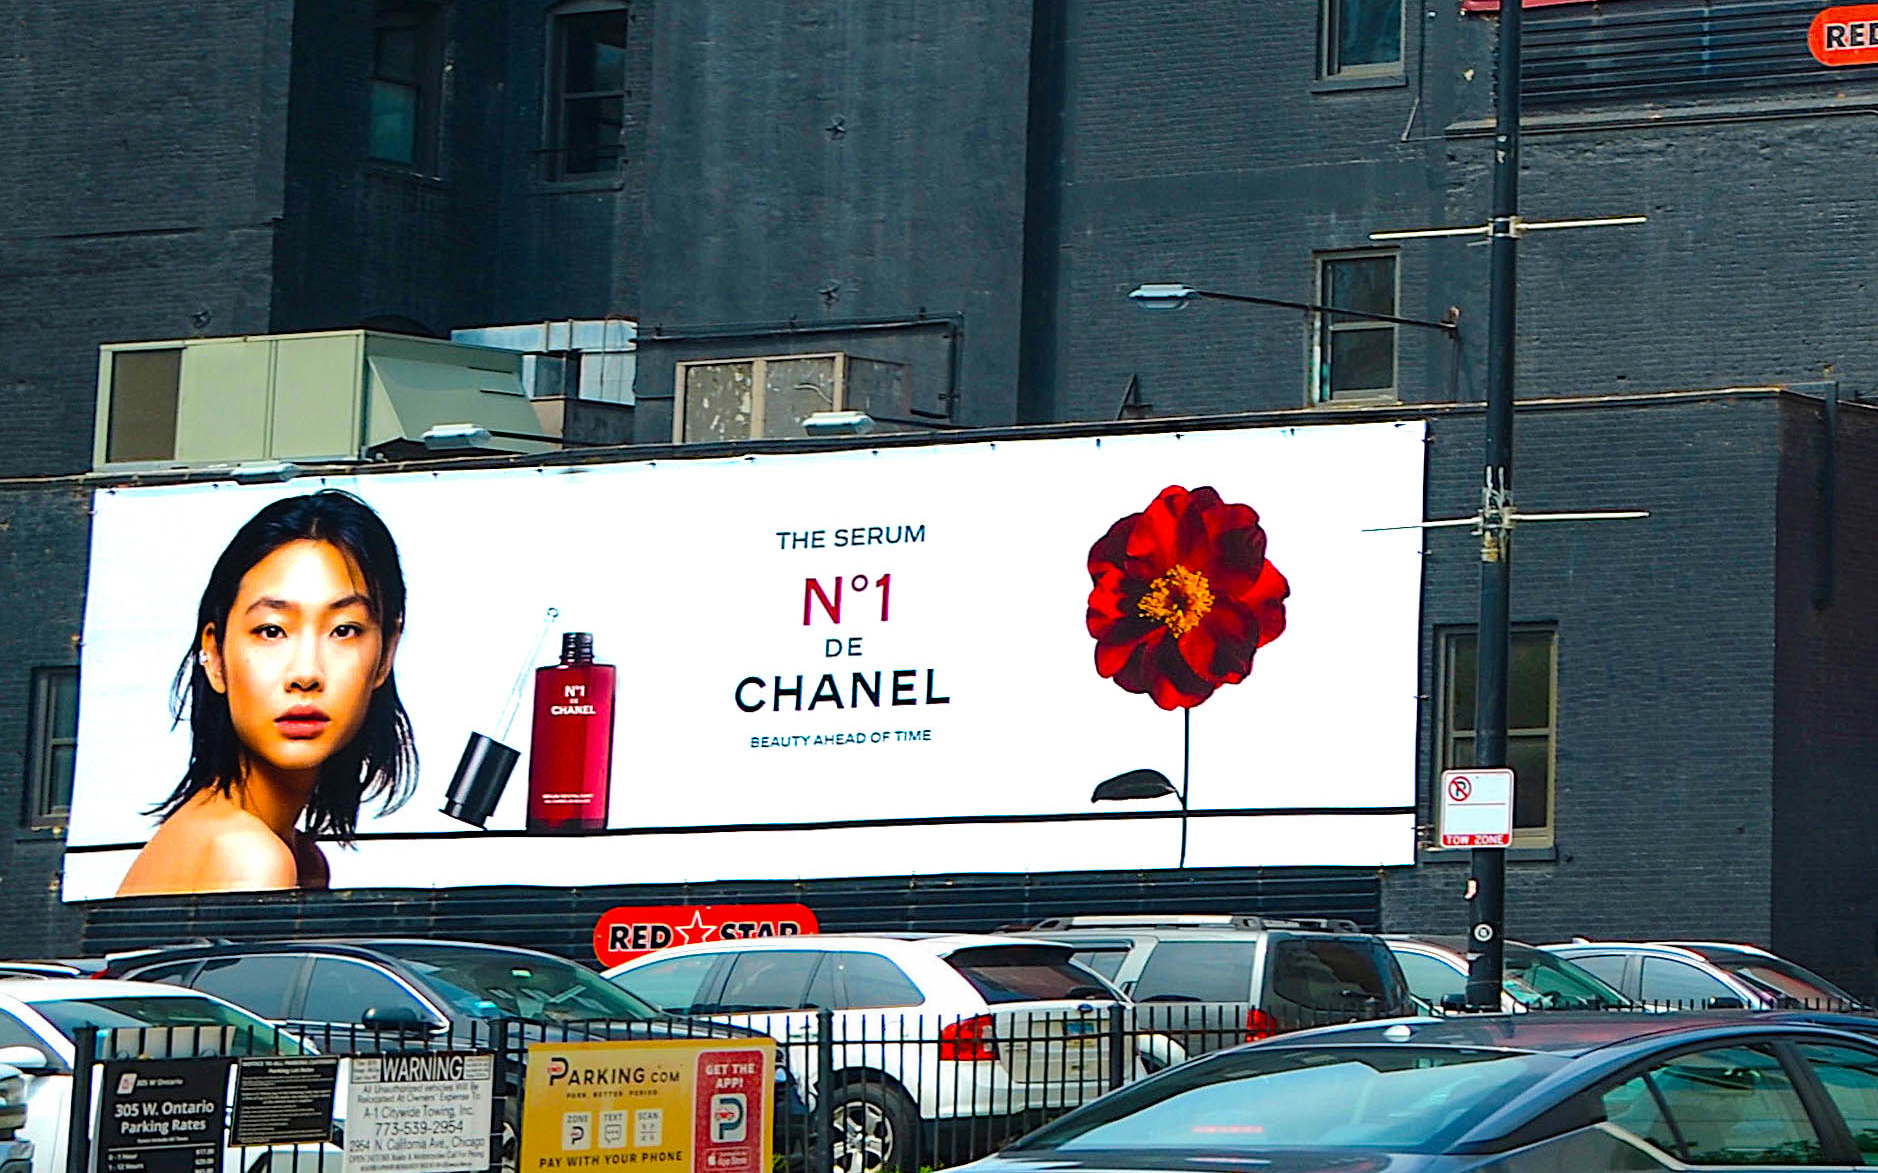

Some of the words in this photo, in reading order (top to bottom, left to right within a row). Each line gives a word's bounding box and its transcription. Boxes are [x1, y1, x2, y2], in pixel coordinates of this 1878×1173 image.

[776, 530, 826, 550] THE
[834, 524, 926, 548] SERUM
[825, 637, 863, 658] DE
[735, 668, 950, 713] CHANEL
[551, 705, 597, 715] CHANEL
[750, 735, 811, 748] BEAUTY
[813, 732, 867, 746] AHEAD
[870, 731, 891, 744] OF
[895, 729, 932, 742] TIME
[1447, 835, 1469, 845] TOW
[1474, 834, 1504, 845] ZONE
[608, 923, 674, 952] RED
[383, 1055, 463, 1082] WARNING
[549, 1057, 645, 1086] PARKING
[705, 1064, 728, 1075] GET
[732, 1063, 755, 1074] THE
[716, 1077, 744, 1089] APP!
[114, 1103, 140, 1118] 305
[142, 1102, 159, 1116] W.
[161, 1099, 215, 1116] Ontario
[363, 1107, 378, 1118] A-1
[381, 1106, 420, 1120] Citywide
[638, 1112, 658, 1121] SCAN
[567, 1114, 588, 1124] ZONE
[604, 1113, 623, 1122] TEXT
[120, 1120, 169, 1136] Parking
[172, 1119, 207, 1131] Rates
[375, 1120, 464, 1136] 773-539-2954
[349, 1140, 370, 1153] 2954
[386, 1137, 427, 1151] California
[451, 1136, 485, 1150] Chicago
[539, 1157, 562, 1168] PAY
[567, 1155, 599, 1167] WITH
[605, 1153, 637, 1165] YOUR
[642, 1151, 683, 1163] PHONE
